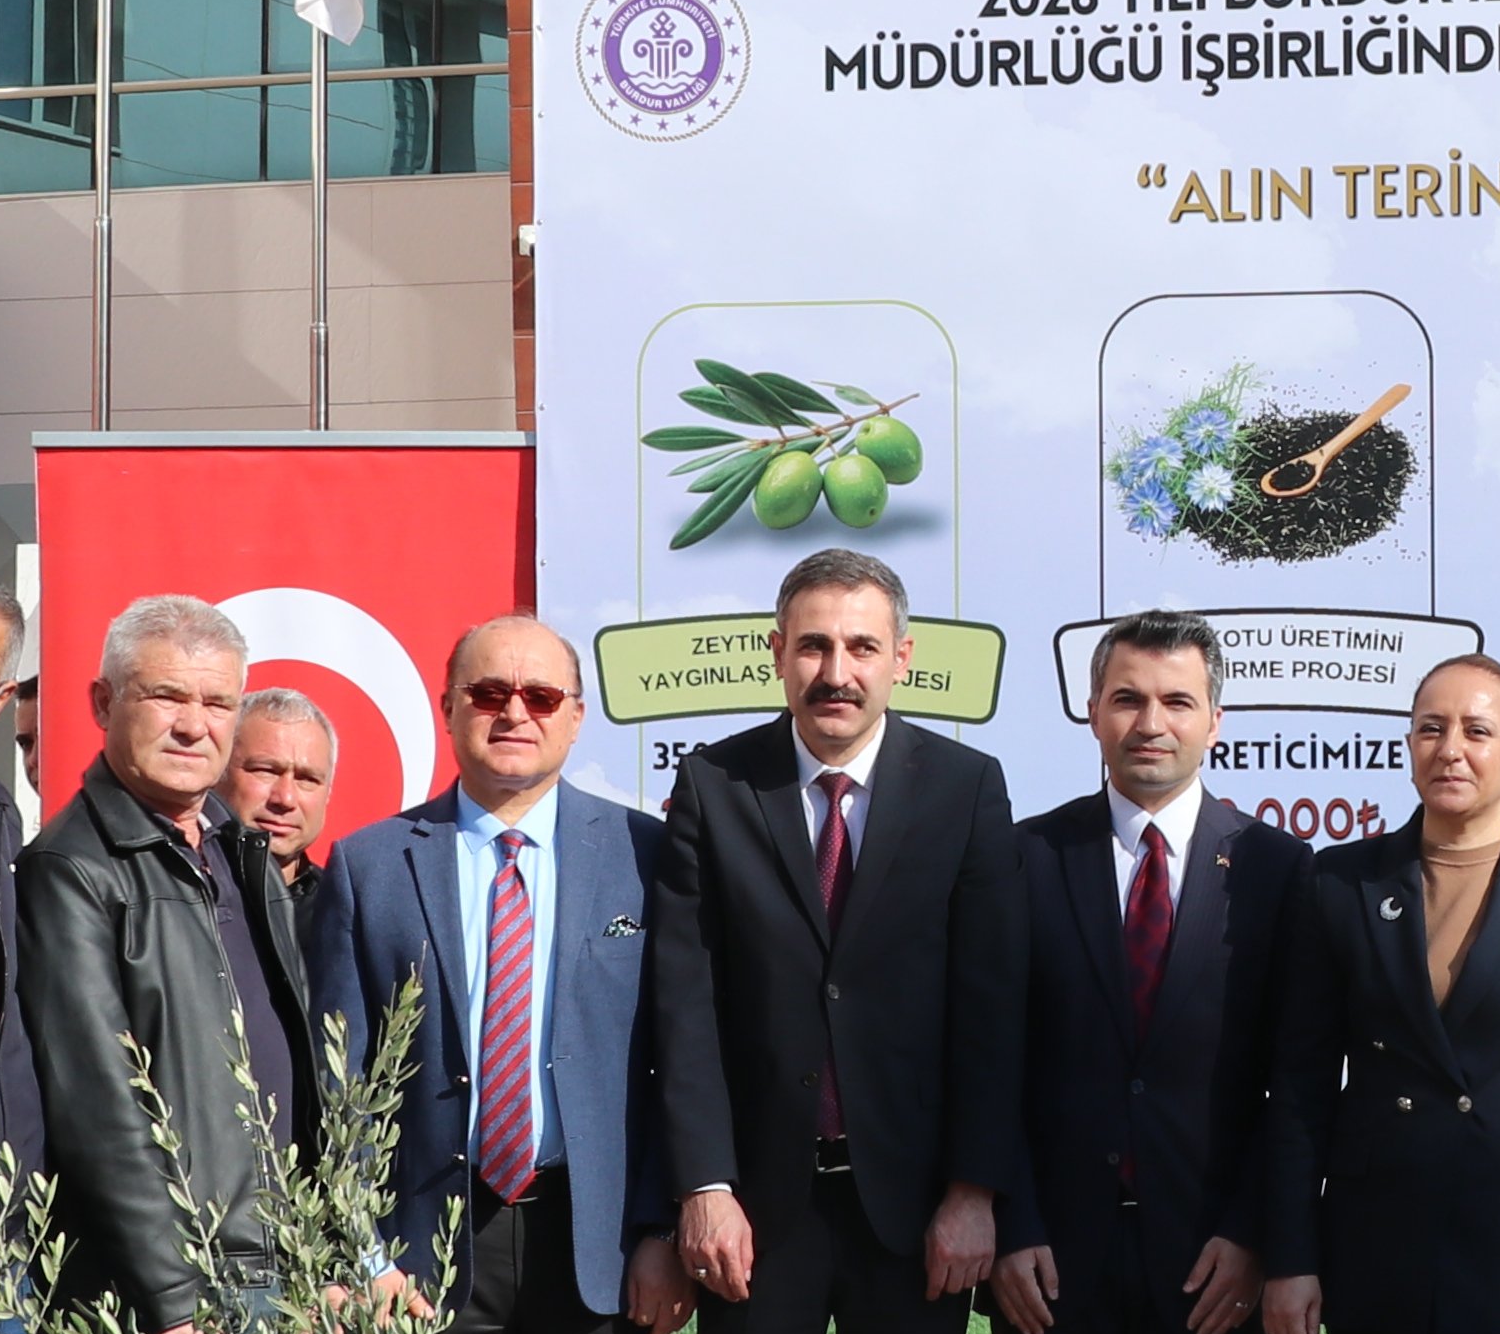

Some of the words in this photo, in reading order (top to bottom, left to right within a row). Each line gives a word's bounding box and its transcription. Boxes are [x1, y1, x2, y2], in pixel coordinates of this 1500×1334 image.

[824, 25, 1164, 93] MÜDÜRLÜĞÜ
[618, 78, 663, 109] BURDUR
[664, 78, 708, 110] VALİLİĞİ
[1281, 624, 1404, 654] ÜRETİMİNİ
[1291, 659, 1397, 685] PROJESİ
[1208, 732, 1404, 771] RETİCİMİZE
